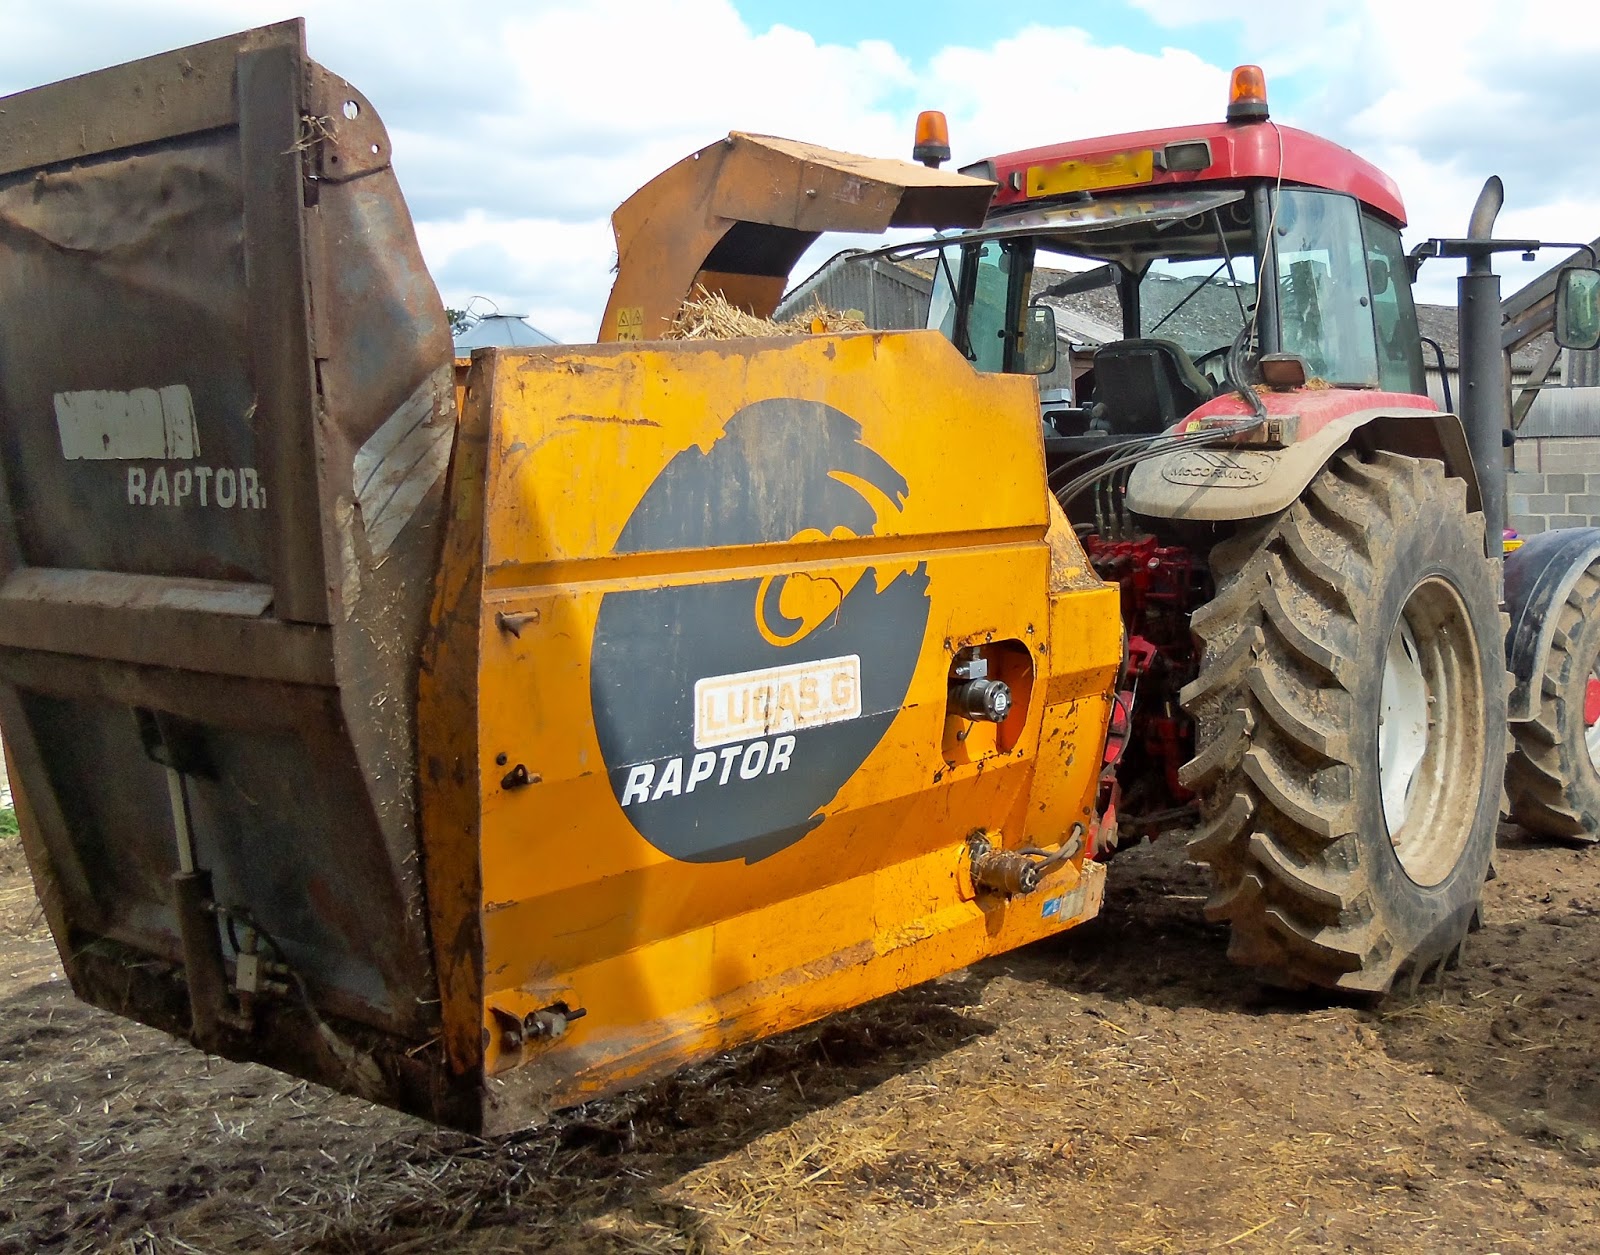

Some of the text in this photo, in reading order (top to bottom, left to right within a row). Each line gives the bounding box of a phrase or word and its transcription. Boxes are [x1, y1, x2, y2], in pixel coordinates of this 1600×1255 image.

[706, 672, 852, 730] LUCAS G
[621, 735, 796, 807] RAPTOR
